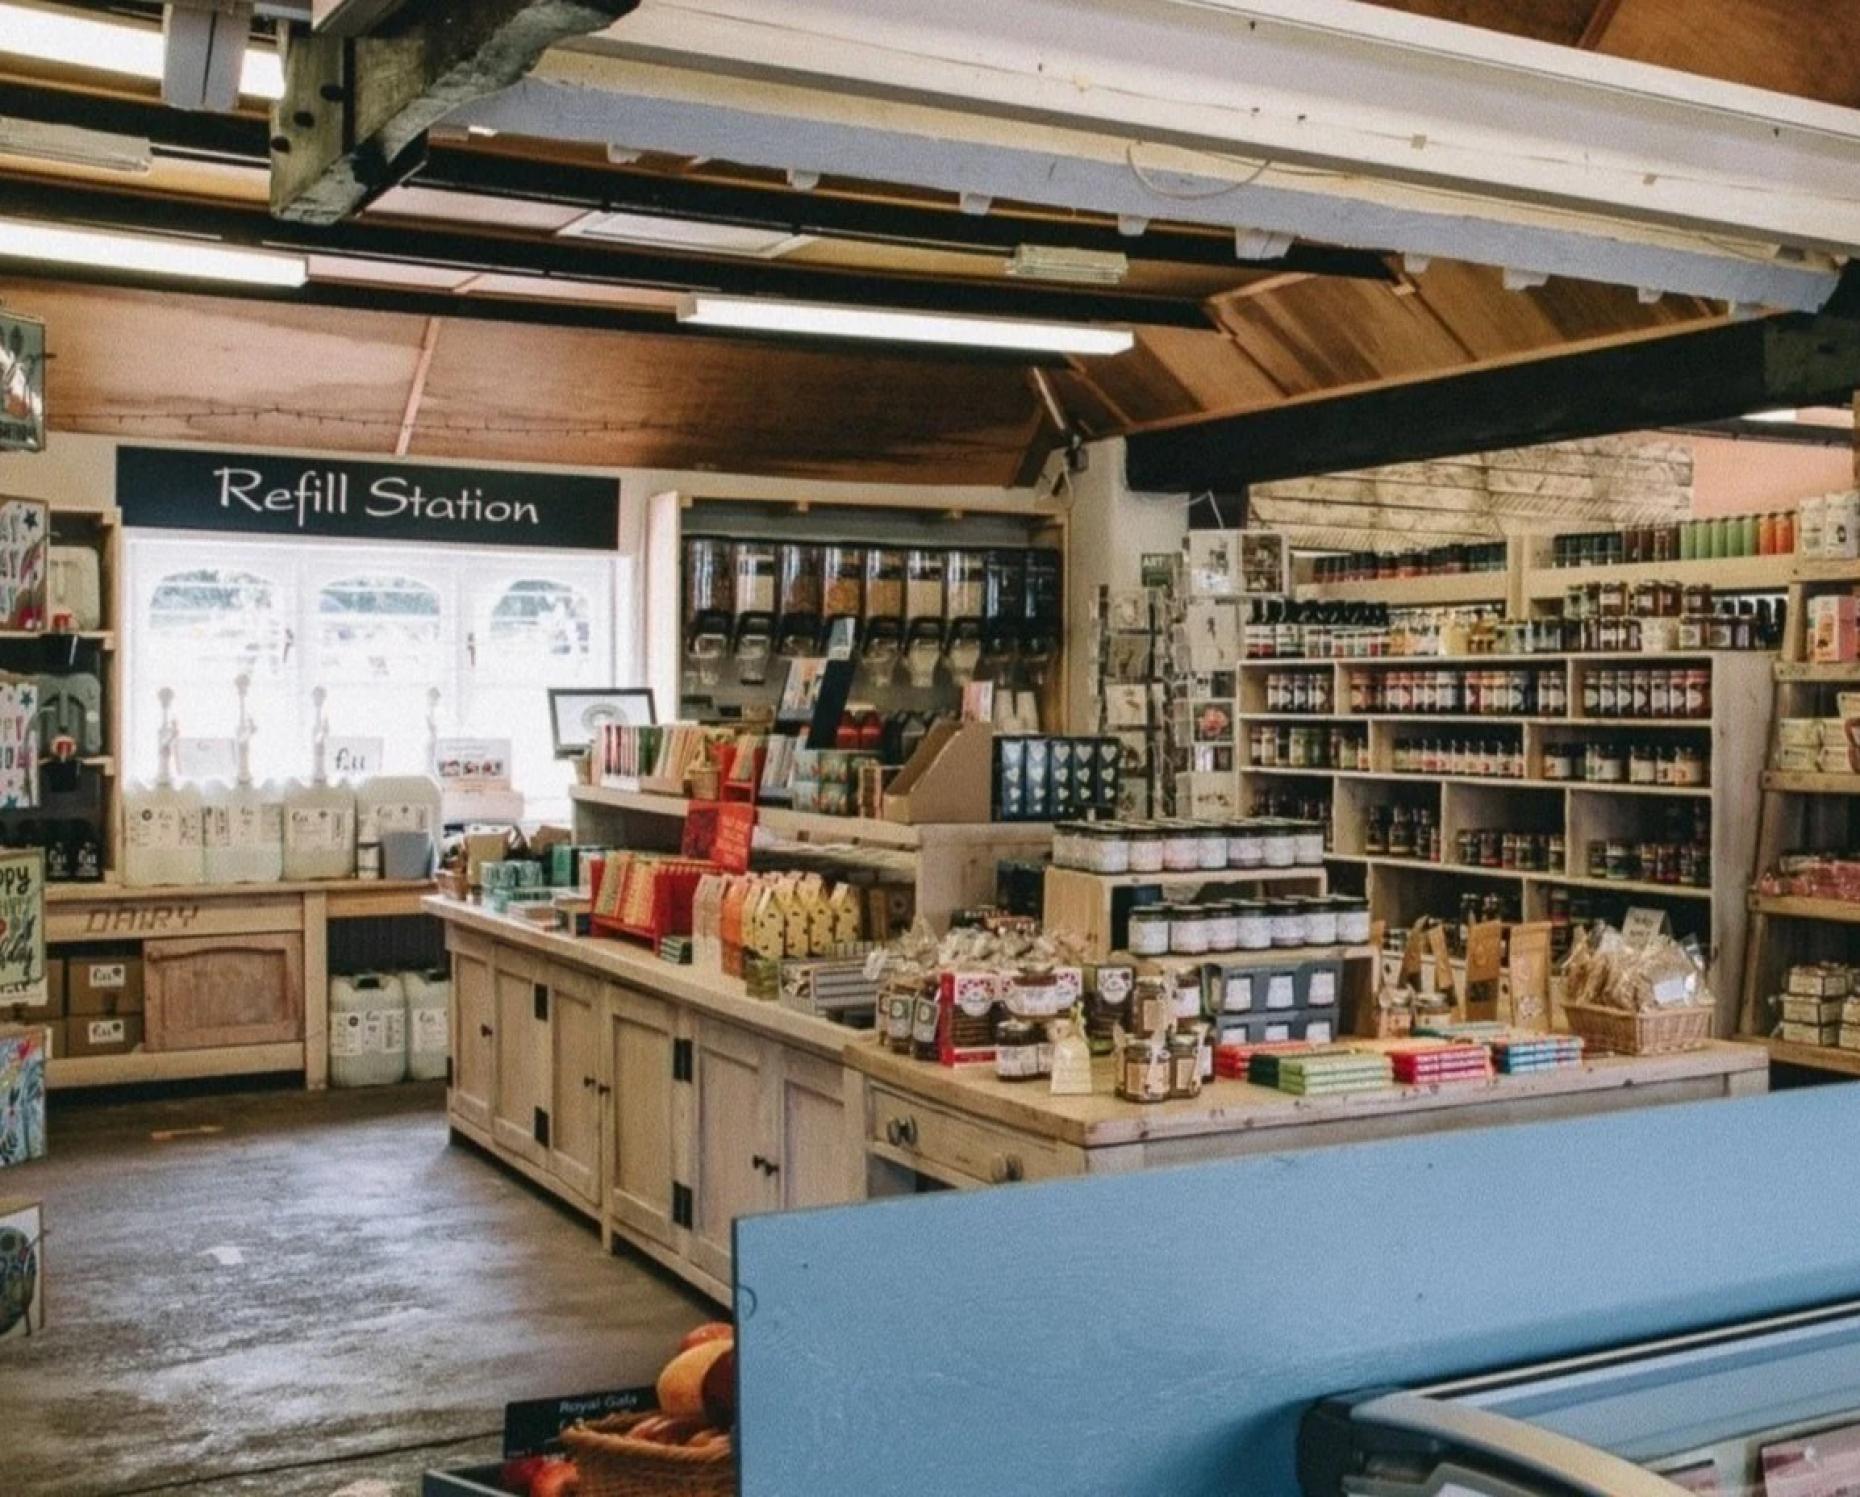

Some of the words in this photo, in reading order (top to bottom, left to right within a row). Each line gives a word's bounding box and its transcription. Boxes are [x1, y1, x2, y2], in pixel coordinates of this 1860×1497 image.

[212, 466, 348, 528] Refill
[365, 476, 539, 525] Station
[86, 905, 199, 933] DAIRY
[559, 1398, 601, 1414] Royal
[604, 1394, 637, 1407] Gala
